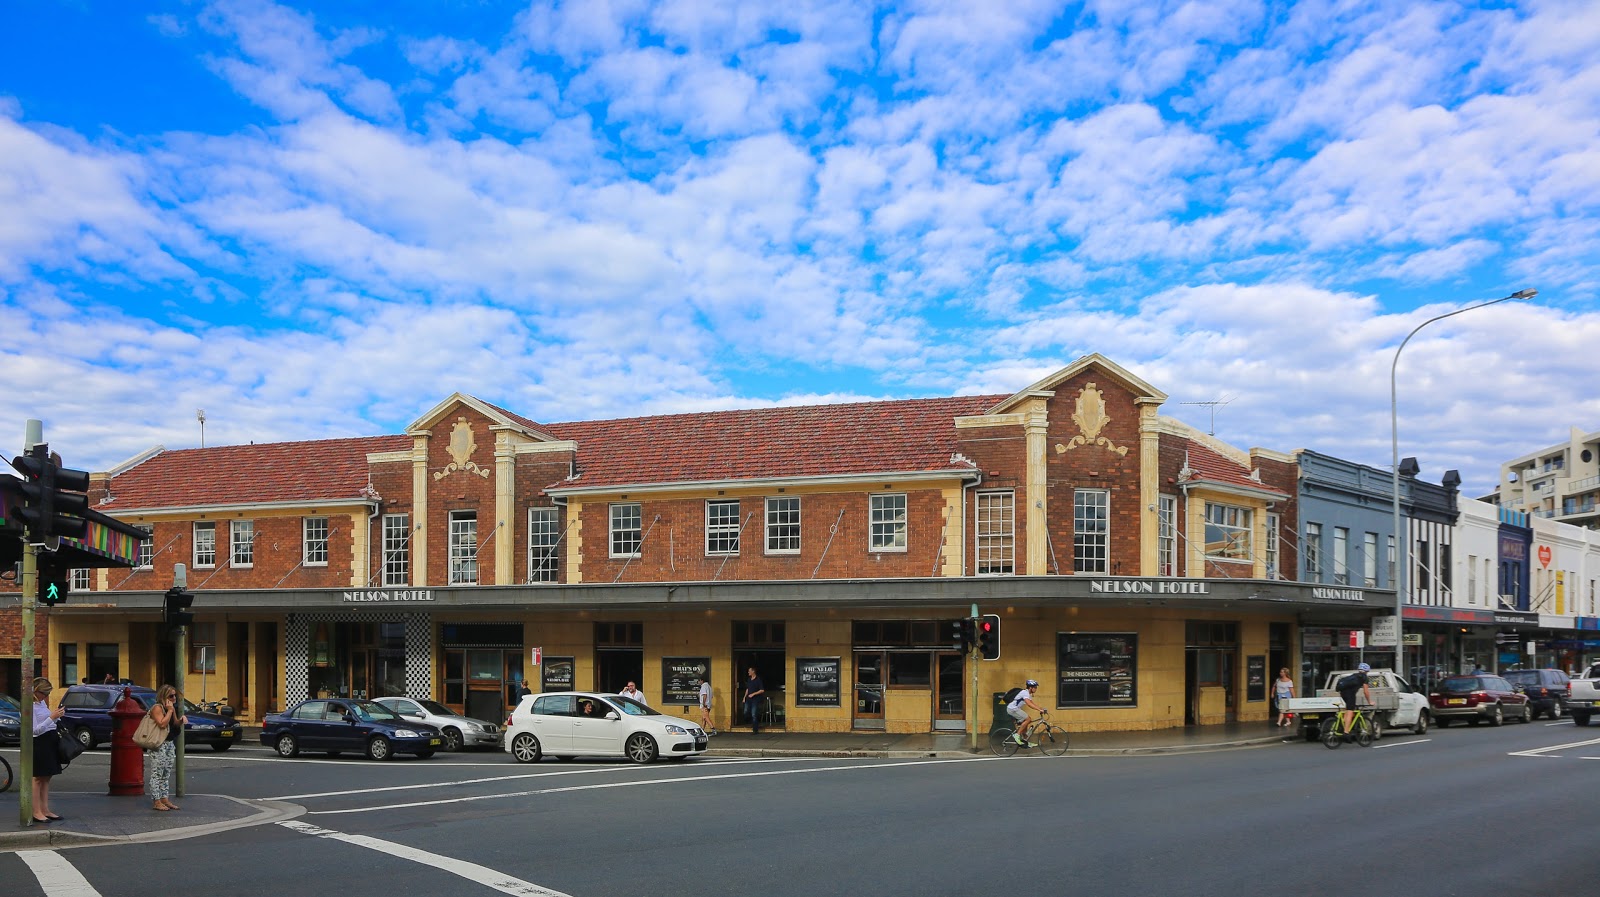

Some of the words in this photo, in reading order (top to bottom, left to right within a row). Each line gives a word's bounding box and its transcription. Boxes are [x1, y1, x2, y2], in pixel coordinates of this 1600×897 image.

[1091, 581, 1152, 593] NELSON
[1158, 581, 1209, 594] HOTEL
[1312, 587, 1341, 599] NELSON
[1341, 589, 1365, 601] HOTEL
[343, 591, 389, 601] NELSON
[393, 590, 434, 601] HOTEL
